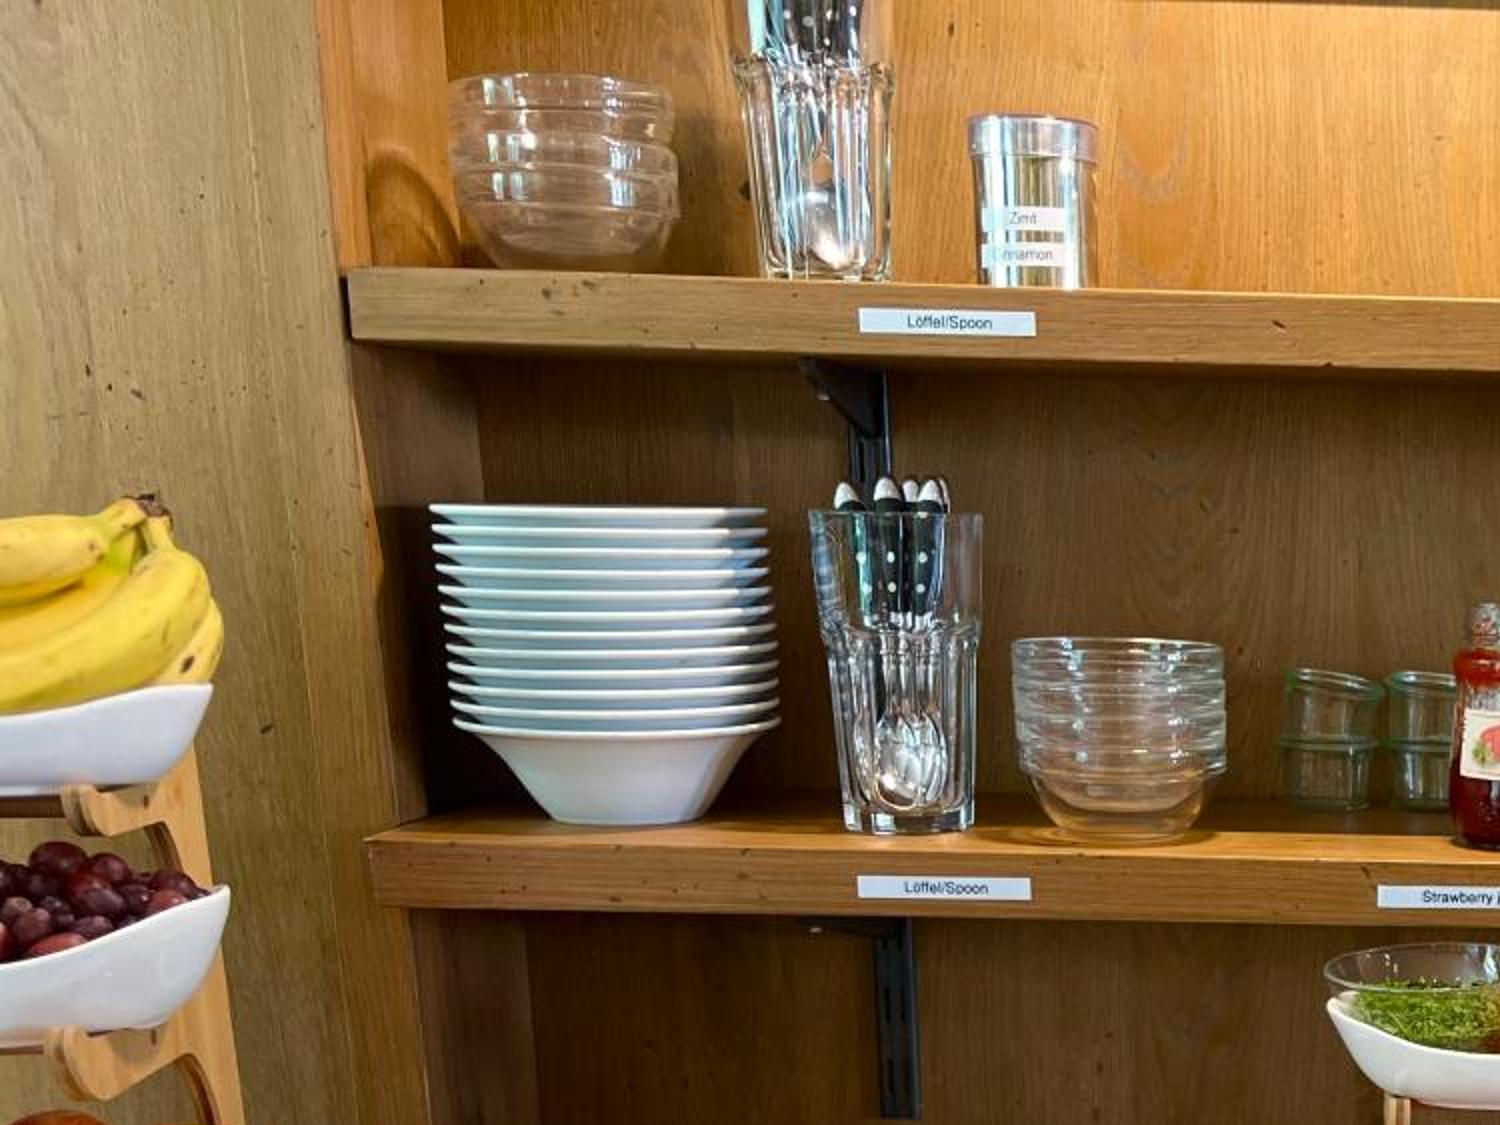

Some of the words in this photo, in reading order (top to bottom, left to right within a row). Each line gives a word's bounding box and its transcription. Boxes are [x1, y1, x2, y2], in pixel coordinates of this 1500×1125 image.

[907, 314, 993, 331] Löffel/Spoon
[904, 880, 989, 896] Löffel/Spoon
[1422, 889, 1493, 906] Strawberry
